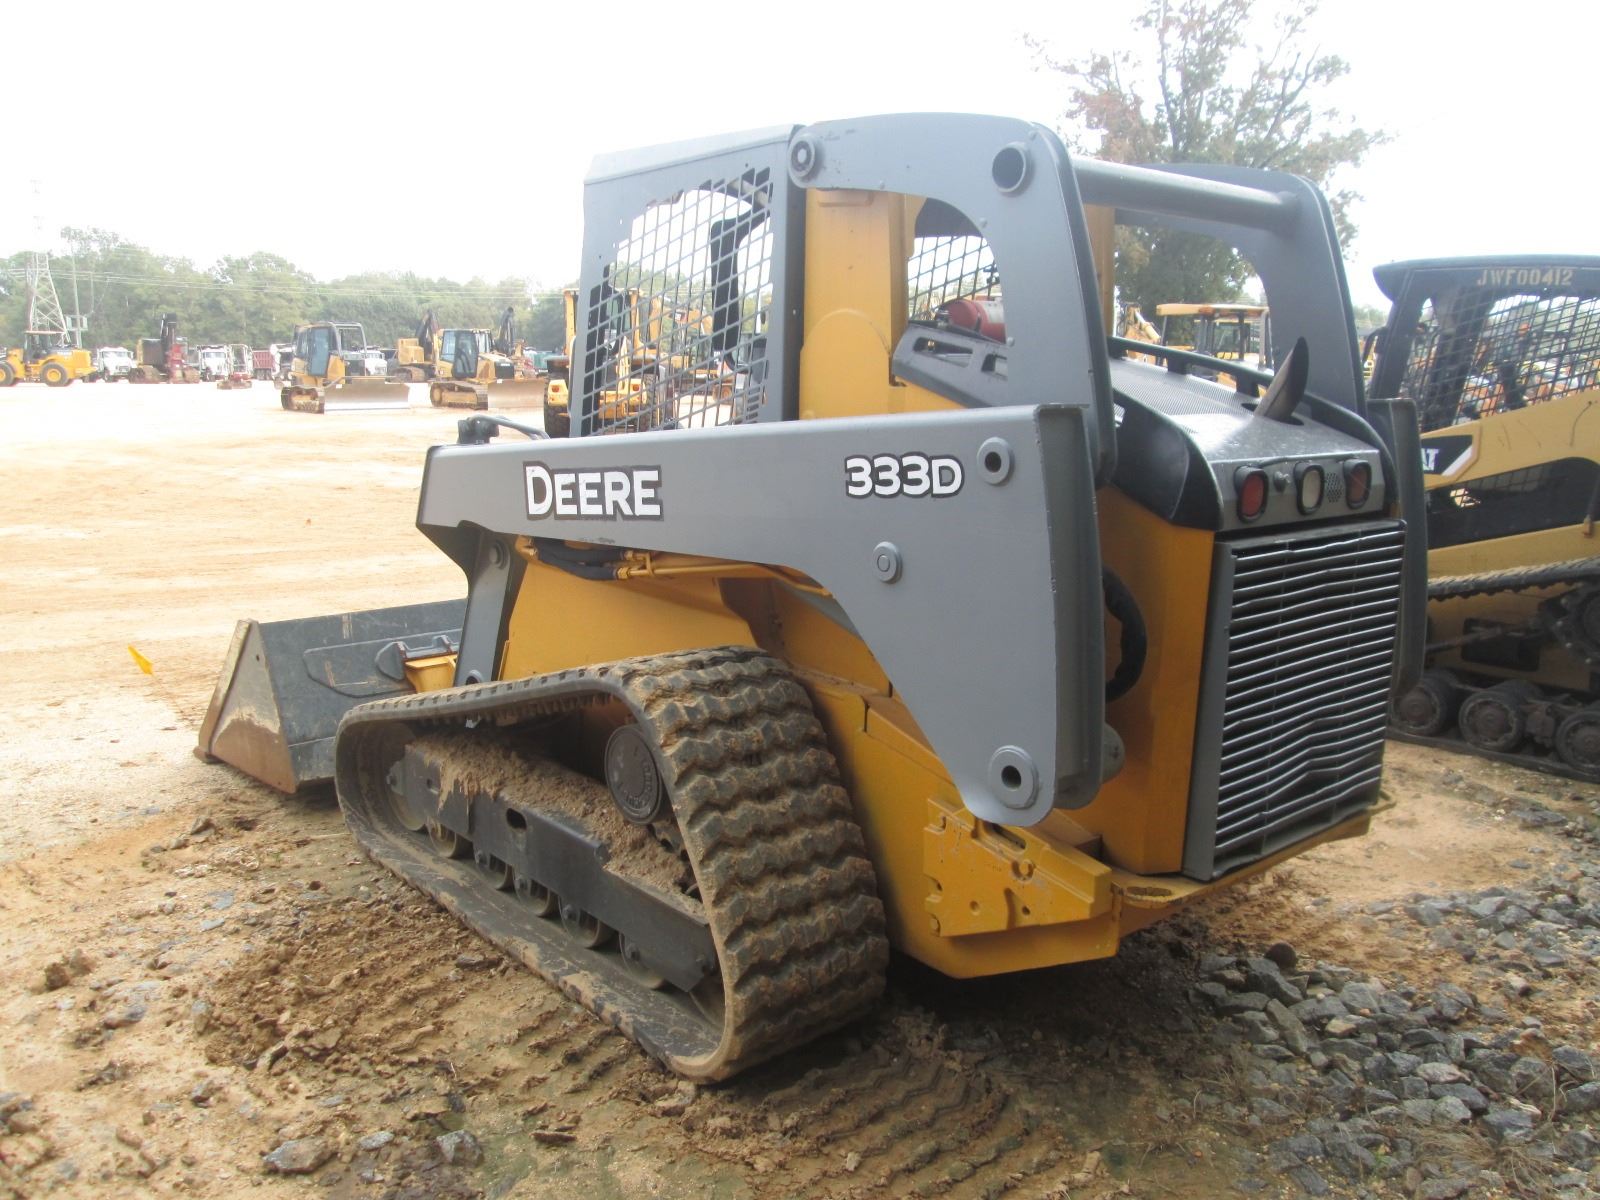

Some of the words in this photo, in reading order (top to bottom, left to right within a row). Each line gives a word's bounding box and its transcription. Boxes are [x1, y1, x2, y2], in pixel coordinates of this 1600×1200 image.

[1477, 268, 1574, 286] JWF00412
[524, 463, 663, 518] DEERE
[845, 454, 964, 498] 333D
